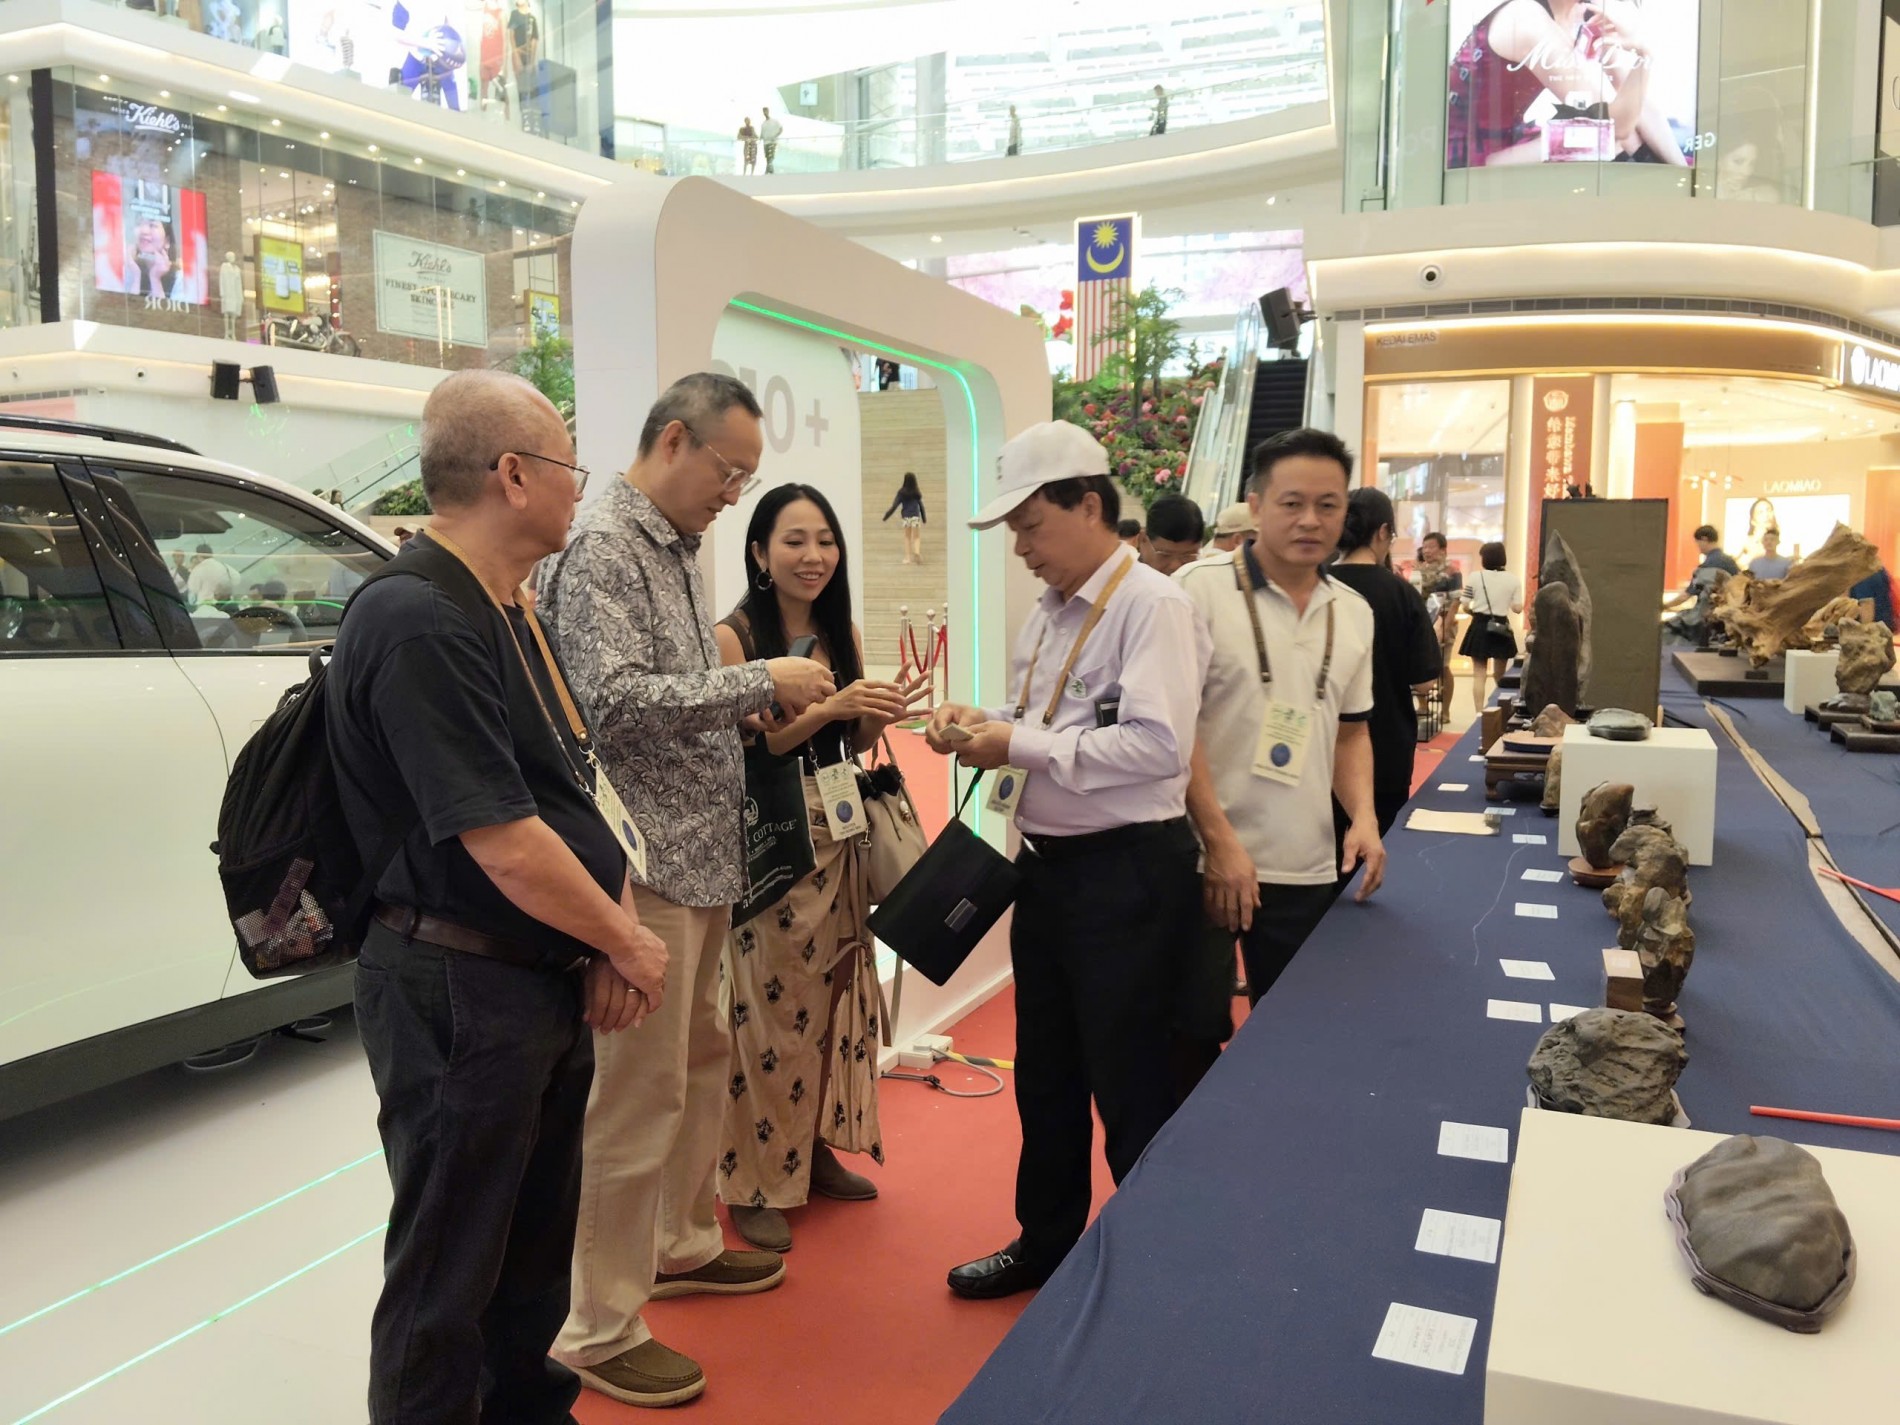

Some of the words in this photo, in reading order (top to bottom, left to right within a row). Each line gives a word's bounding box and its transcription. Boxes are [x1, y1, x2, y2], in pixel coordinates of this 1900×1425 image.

[125, 103, 180, 132] Kiehl's
[408, 250, 452, 274] Kiehl's
[385, 278, 417, 291] FINEST
[410, 294, 455, 310] SKINCRE
[1376, 334, 1406, 347] KEDAI
[1407, 331, 1437, 344] EMAS
[1865, 355, 1900, 392] LAOM
[1763, 478, 1822, 494] LAOMIAO
[753, 821, 796, 843] COTTAGE
